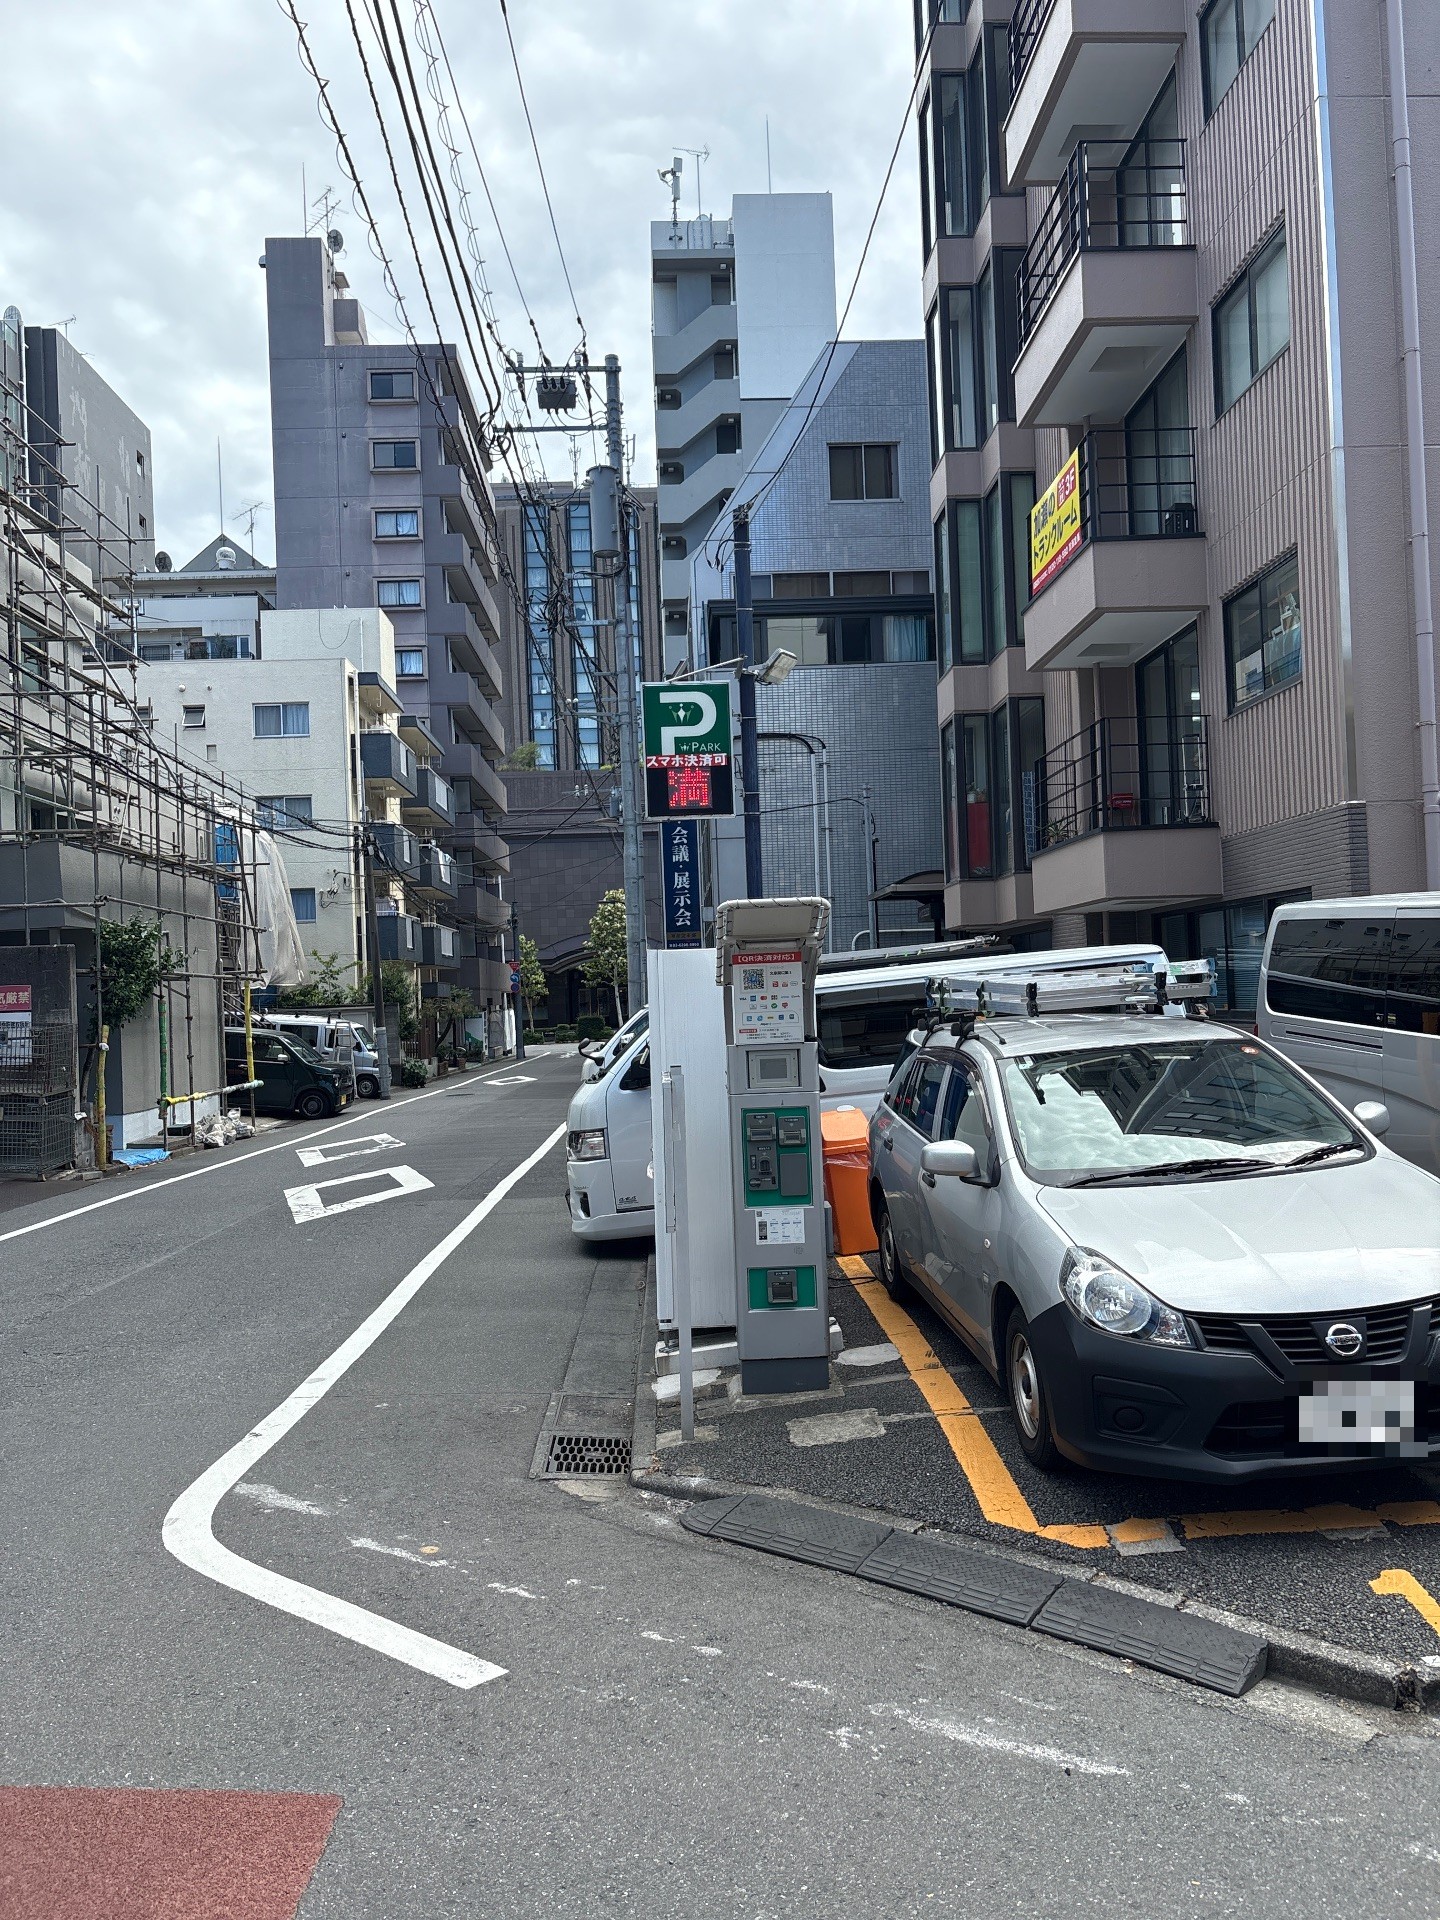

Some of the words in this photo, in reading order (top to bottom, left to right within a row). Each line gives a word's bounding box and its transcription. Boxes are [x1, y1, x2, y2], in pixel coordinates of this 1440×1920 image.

[1033, 500, 1077, 569] トランクルーム
[647, 752, 728, 768] スマホ決済可
[668, 768, 711, 808] 満
